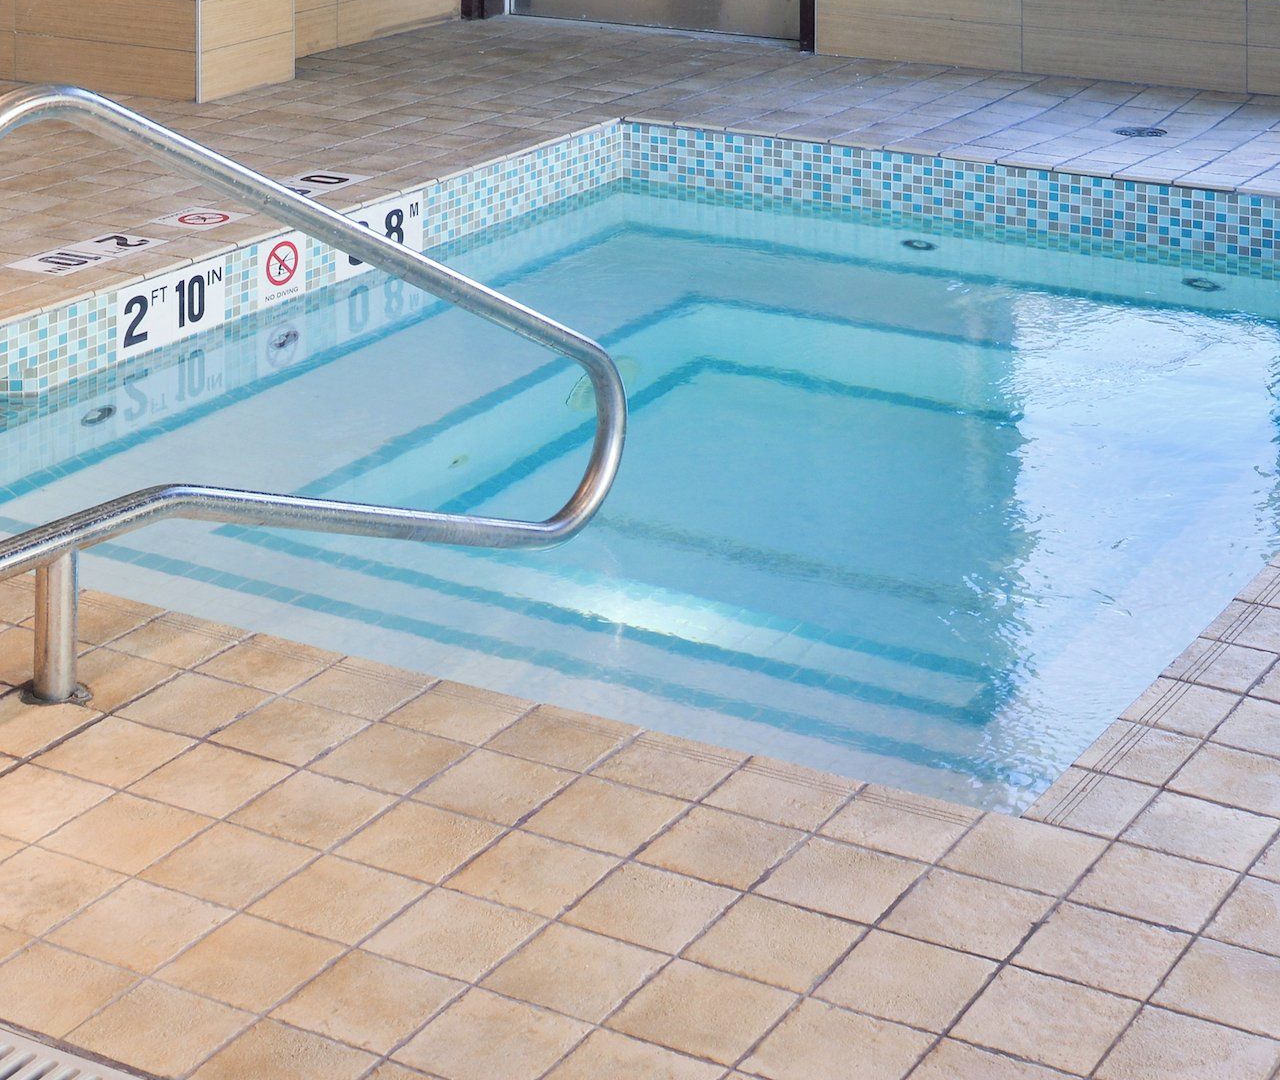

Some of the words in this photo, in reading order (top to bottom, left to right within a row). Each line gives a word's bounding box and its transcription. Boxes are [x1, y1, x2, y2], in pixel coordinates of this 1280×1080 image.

[409, 201, 419, 219] M
[93, 235, 150, 248] 2
[38, 252, 102, 266] 10
[265, 293, 276, 303] NO
[277, 286, 299, 299] DIVING
[123, 294, 148, 348] 2
[151, 285, 168, 307] FT
[175, 274, 205, 329] 10
[207, 266, 222, 286] IN
